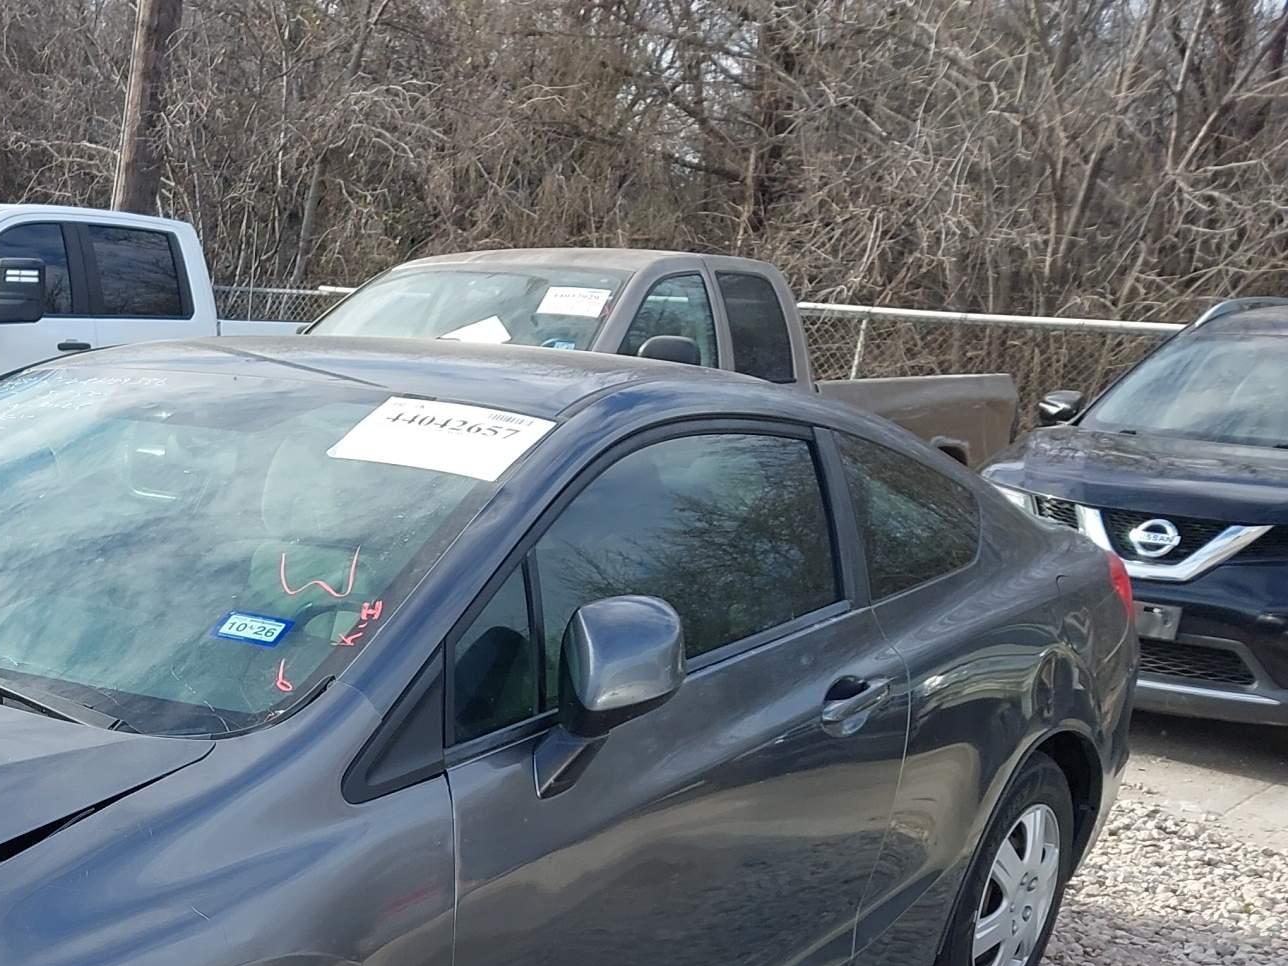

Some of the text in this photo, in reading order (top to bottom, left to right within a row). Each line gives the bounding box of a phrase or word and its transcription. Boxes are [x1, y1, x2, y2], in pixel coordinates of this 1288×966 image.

[385, 411, 522, 440] 44042657
[227, 621, 278, 638] 10 26
